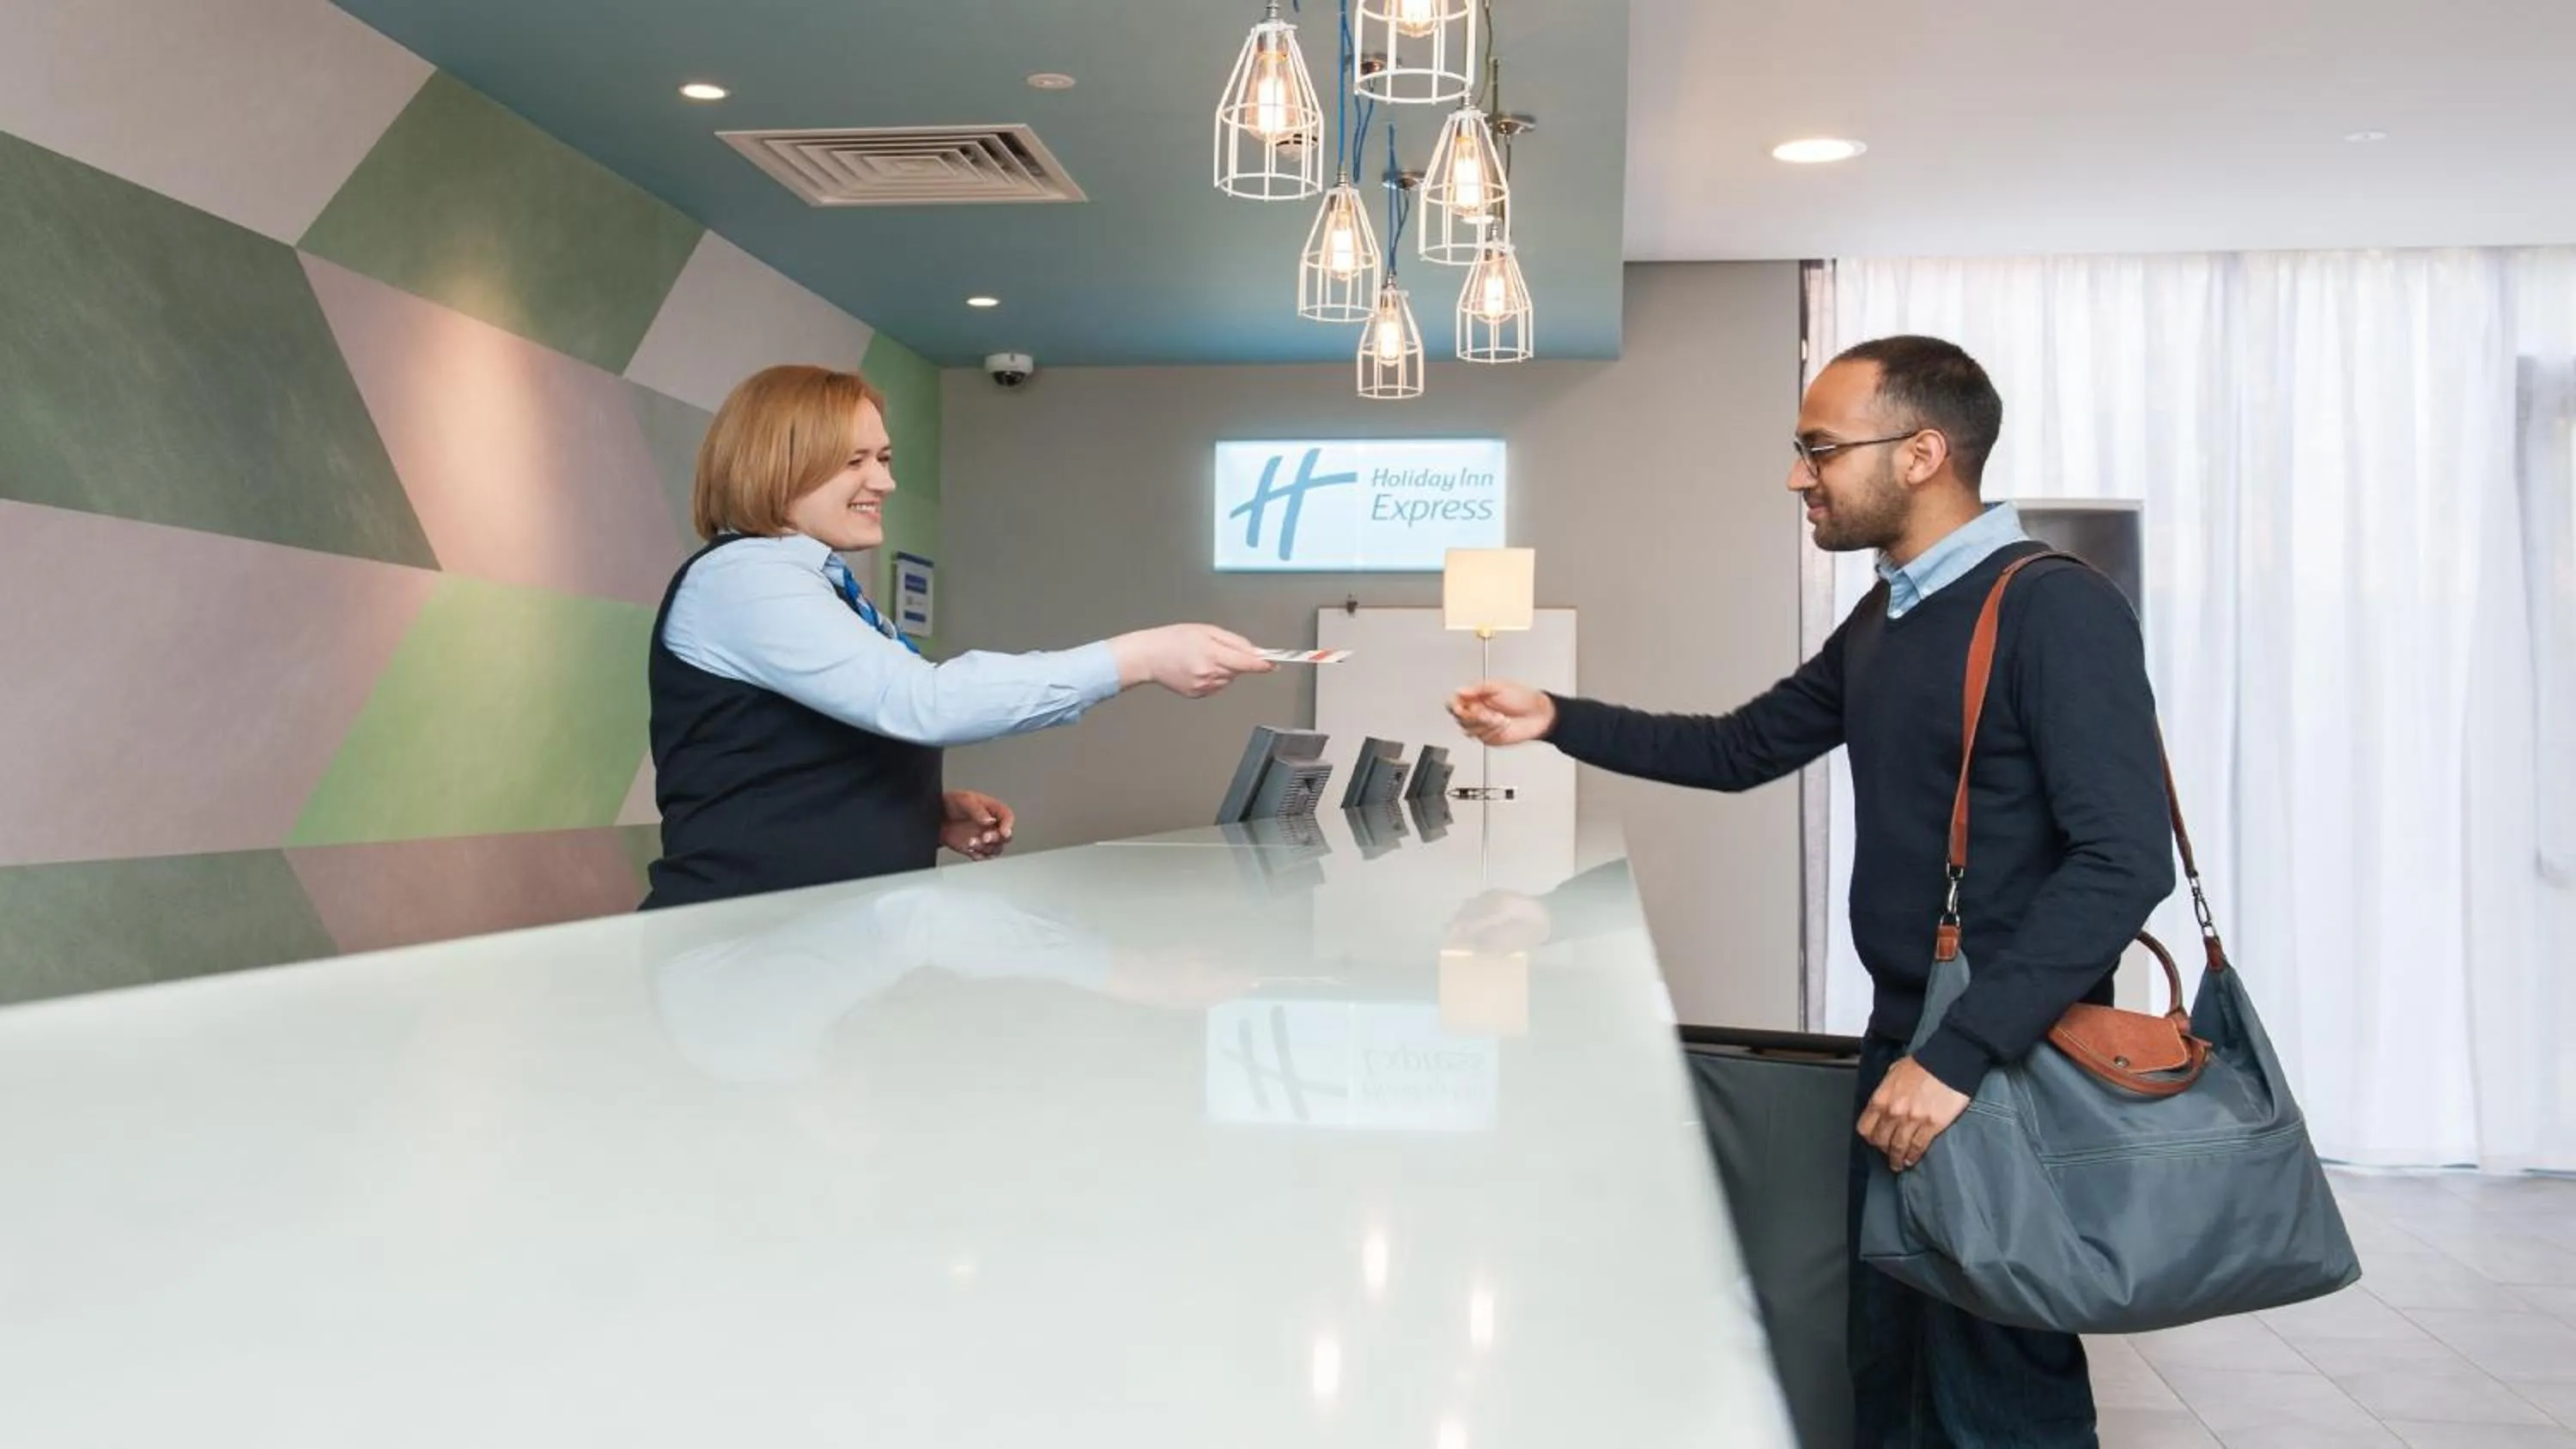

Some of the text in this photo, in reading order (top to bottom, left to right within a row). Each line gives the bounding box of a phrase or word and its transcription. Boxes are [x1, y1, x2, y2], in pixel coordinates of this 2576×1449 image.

[1372, 468, 1495, 491] Holiday Inn
[1371, 494, 1495, 527] Express
